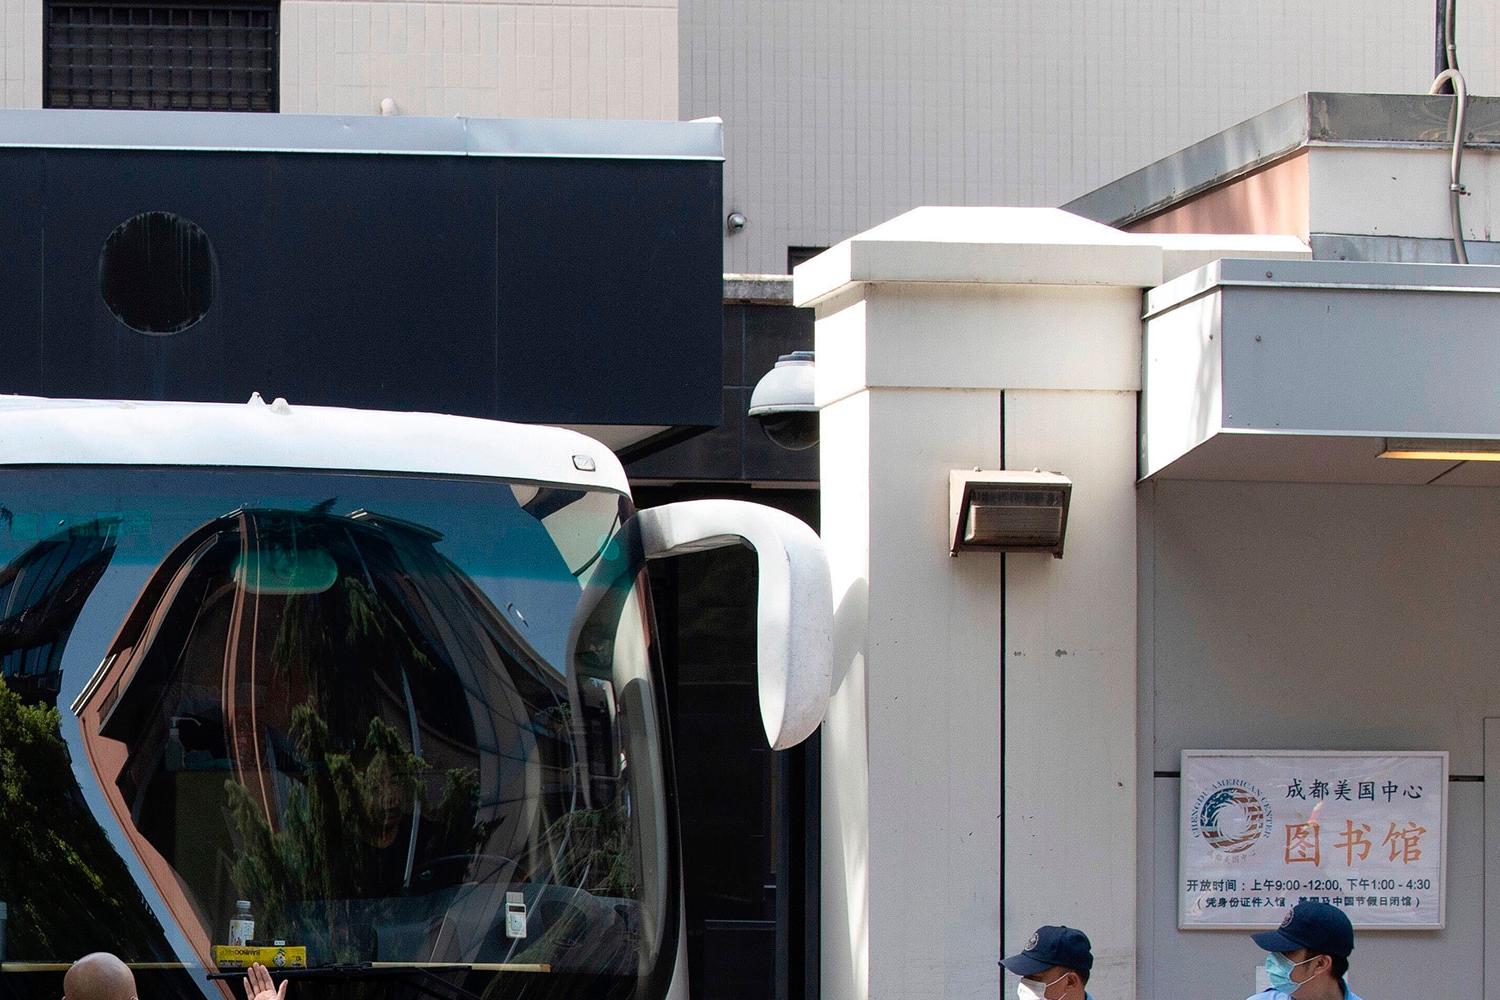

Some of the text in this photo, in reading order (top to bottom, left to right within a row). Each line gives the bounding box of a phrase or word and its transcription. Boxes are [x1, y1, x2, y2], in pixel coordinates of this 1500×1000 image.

[1285, 777, 1423, 802] 成都美国中心
[1284, 819, 1427, 868] 图书馆
[1346, 877, 1395, 891] 下午1:00
[1406, 878, 1431, 890] 4:30
